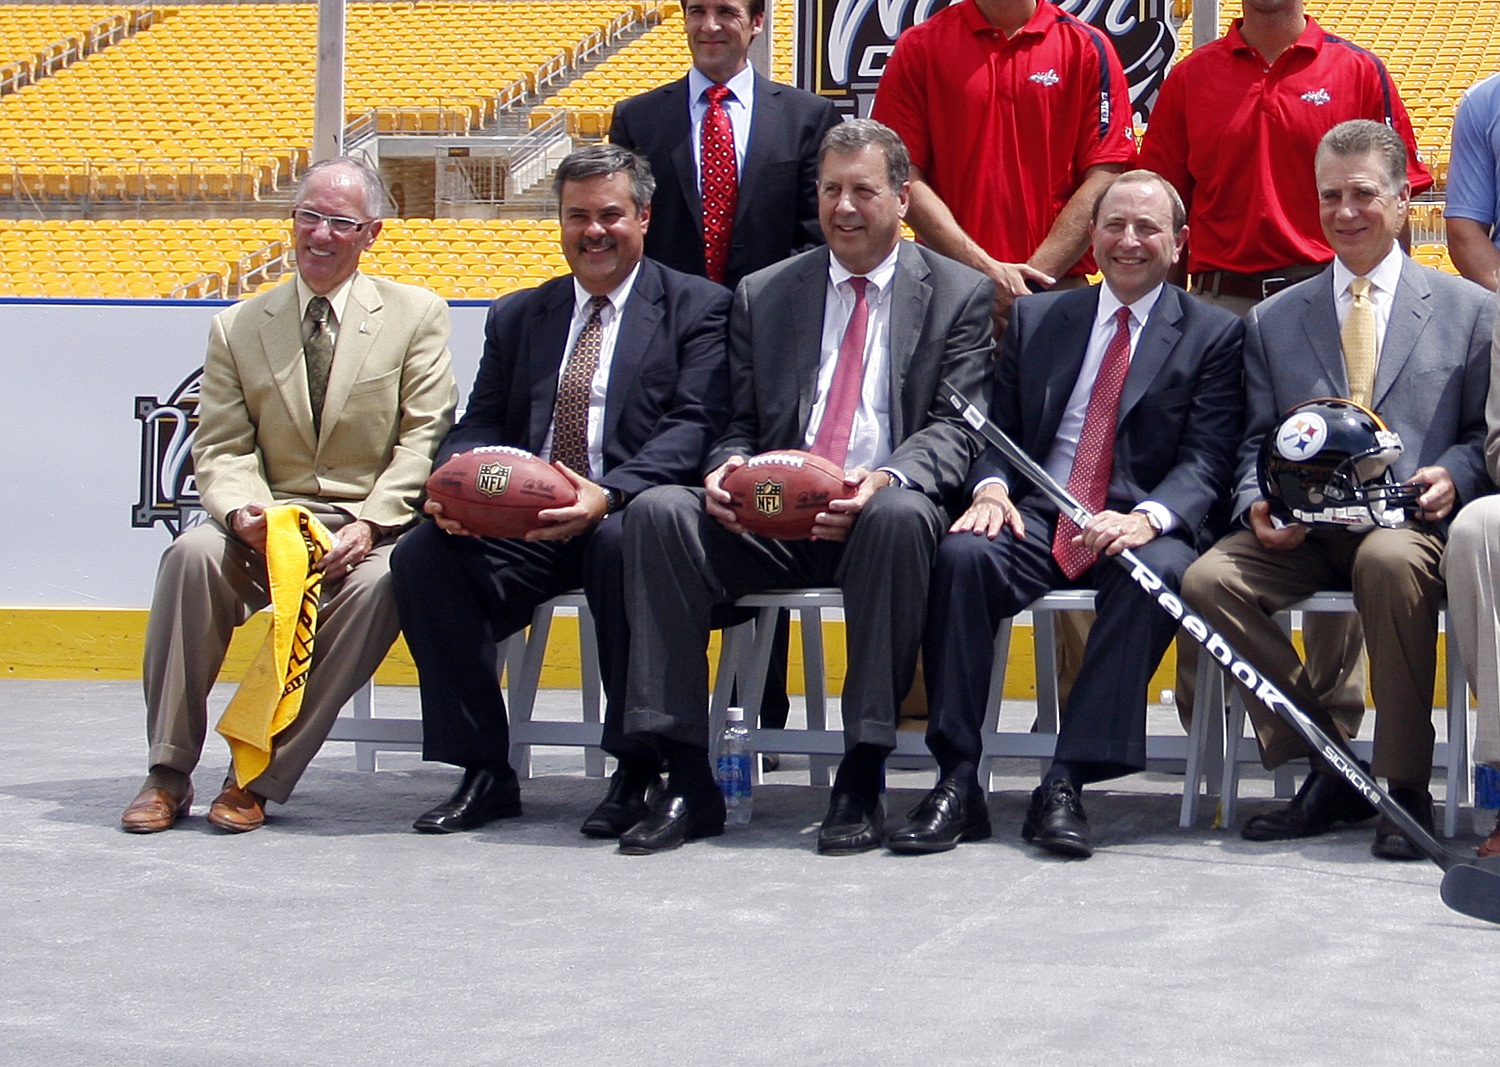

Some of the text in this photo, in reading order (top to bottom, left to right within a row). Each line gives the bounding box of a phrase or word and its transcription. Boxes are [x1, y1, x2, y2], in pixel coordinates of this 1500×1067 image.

[480, 476, 504, 491] NFL
[757, 496, 779, 510] NFL
[1122, 549, 1312, 725] Reebok
[1322, 745, 1371, 796] SICKICK
